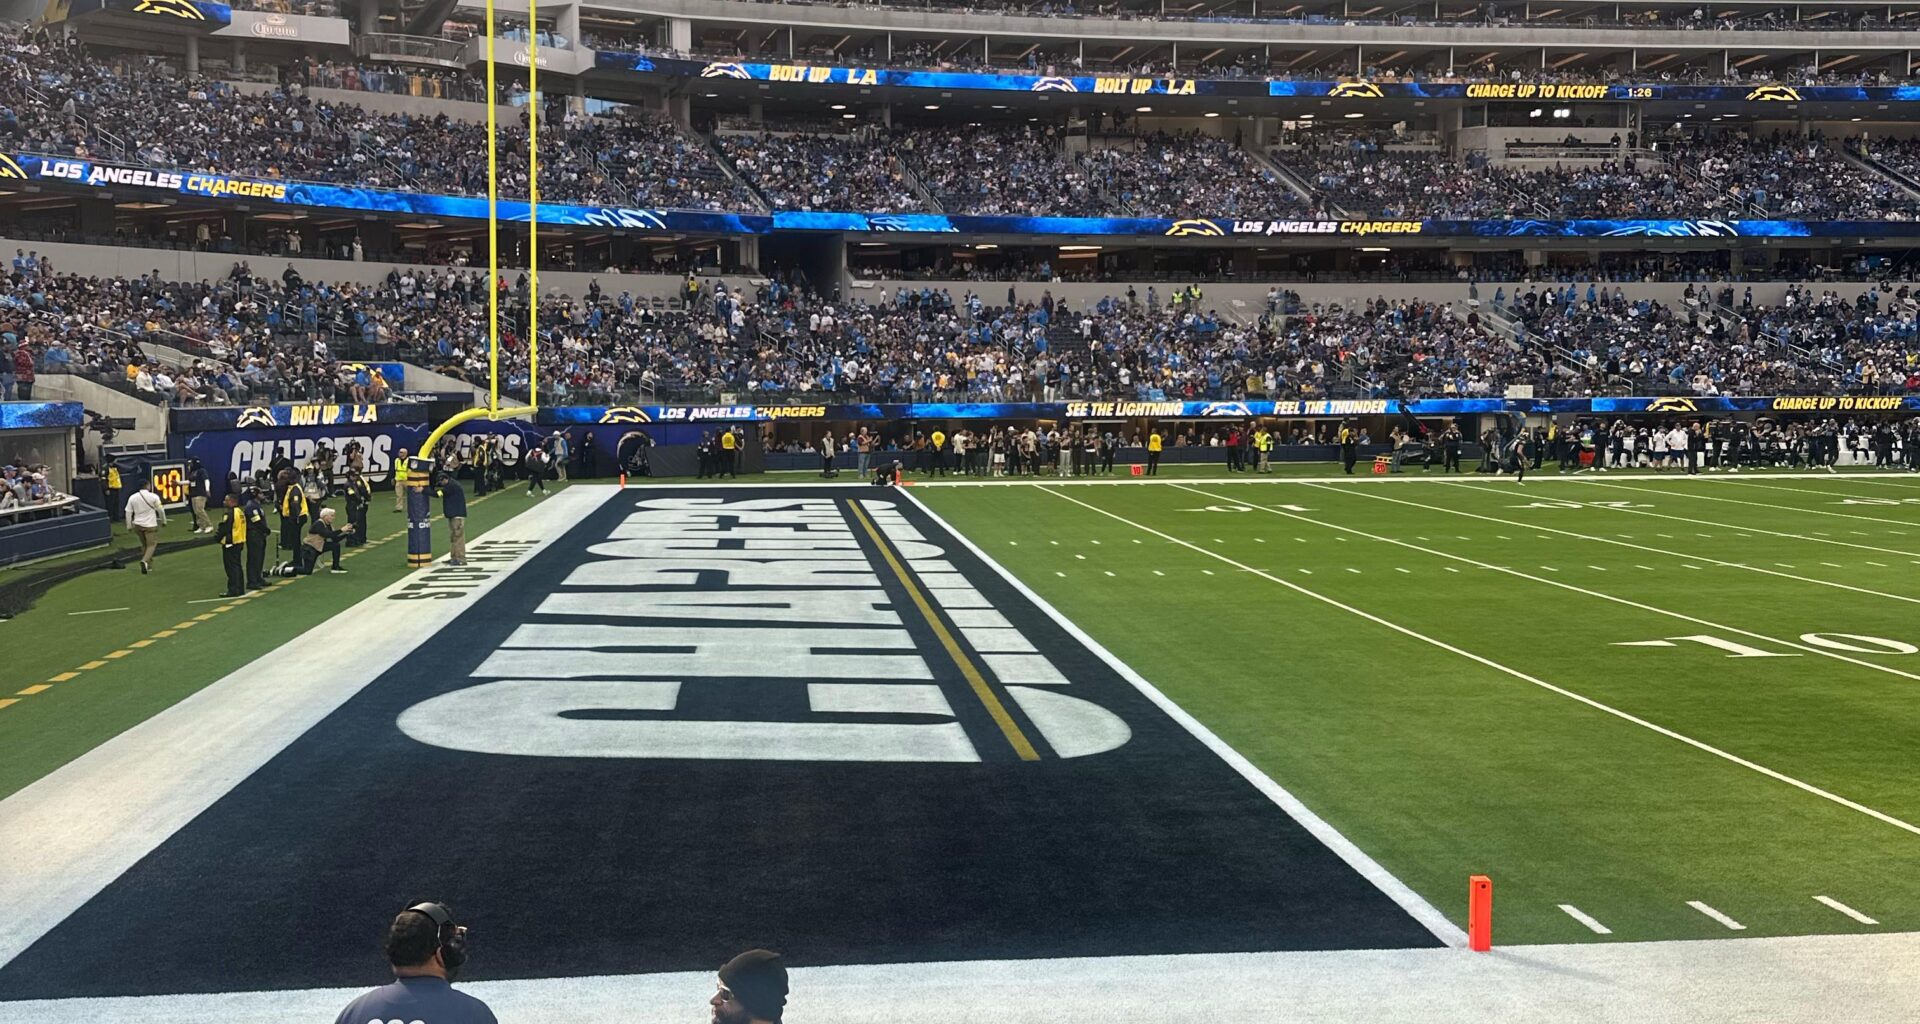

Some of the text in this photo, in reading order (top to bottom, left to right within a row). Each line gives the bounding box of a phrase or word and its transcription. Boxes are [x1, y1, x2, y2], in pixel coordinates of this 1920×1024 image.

[250, 22, 297, 38] Corona
[769, 64, 878, 85] BOLT UP LA
[1094, 77, 1196, 95] BOLT UP LA
[1466, 83, 1608, 99] CHARGE UP TO KICKOFF
[1627, 88, 1652, 98] 1:26
[40, 160, 287, 199] LOS ANGELES CHARGERS
[1233, 221, 1422, 236] LOS ANGELES CHARGERS
[1065, 402, 1184, 417] SEE THE LIGHTNING
[1273, 400, 1386, 414] FEEL THE THUNDER
[1773, 397, 1902, 410] CHARGE UP TO KICKOFF
[290, 404, 378, 426] BOLT UP LA
[658, 406, 826, 422] LOS ANGELES CHARGERS
[154, 470, 181, 502] 40
[387, 567, 500, 600] STOP
[396, 497, 1132, 763] CHARGERS
